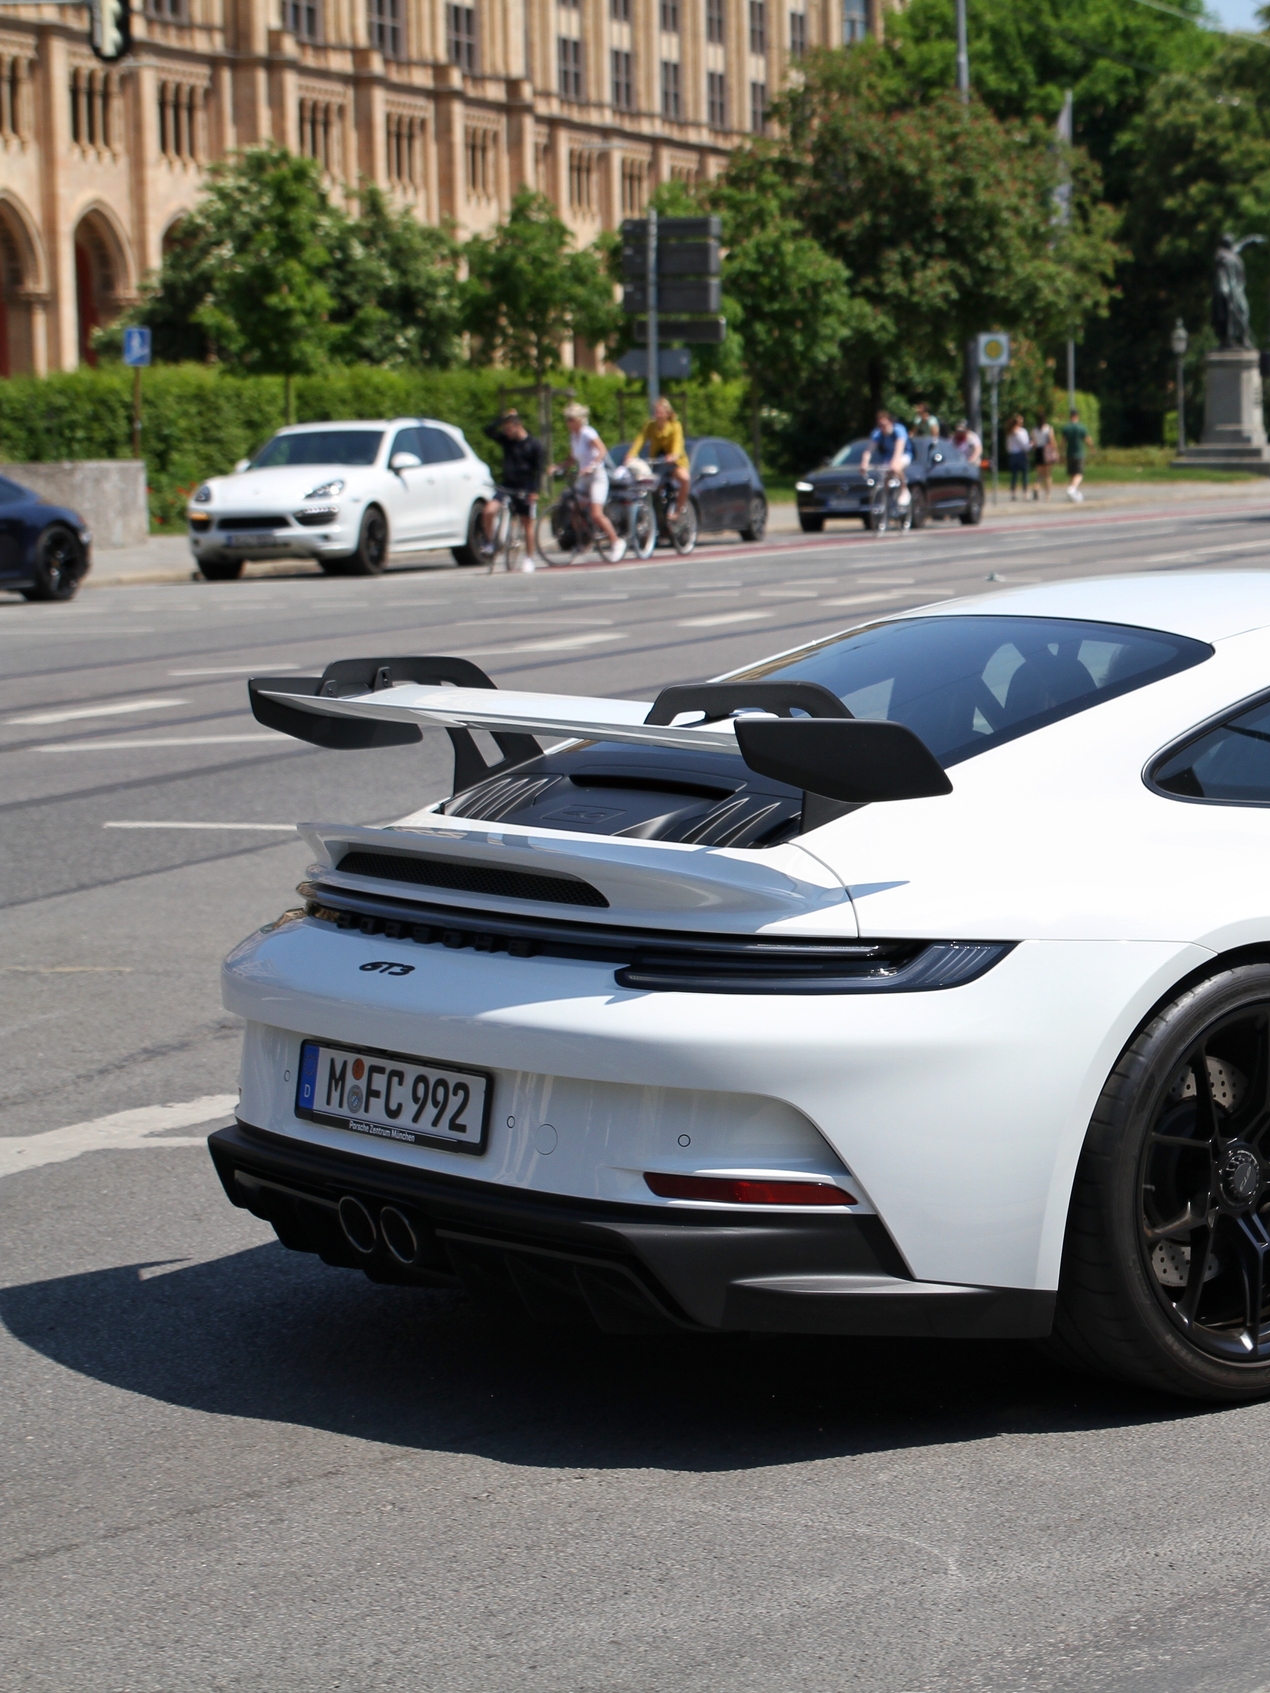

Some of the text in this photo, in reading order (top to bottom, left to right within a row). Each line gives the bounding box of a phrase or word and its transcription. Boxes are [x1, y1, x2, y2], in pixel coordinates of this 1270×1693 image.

[359, 961, 415, 976] GT3
[304, 1084, 310, 1098] D
[326, 1058, 470, 1134] M FC 992
[349, 1120, 415, 1142] Porsche Zentrum München
